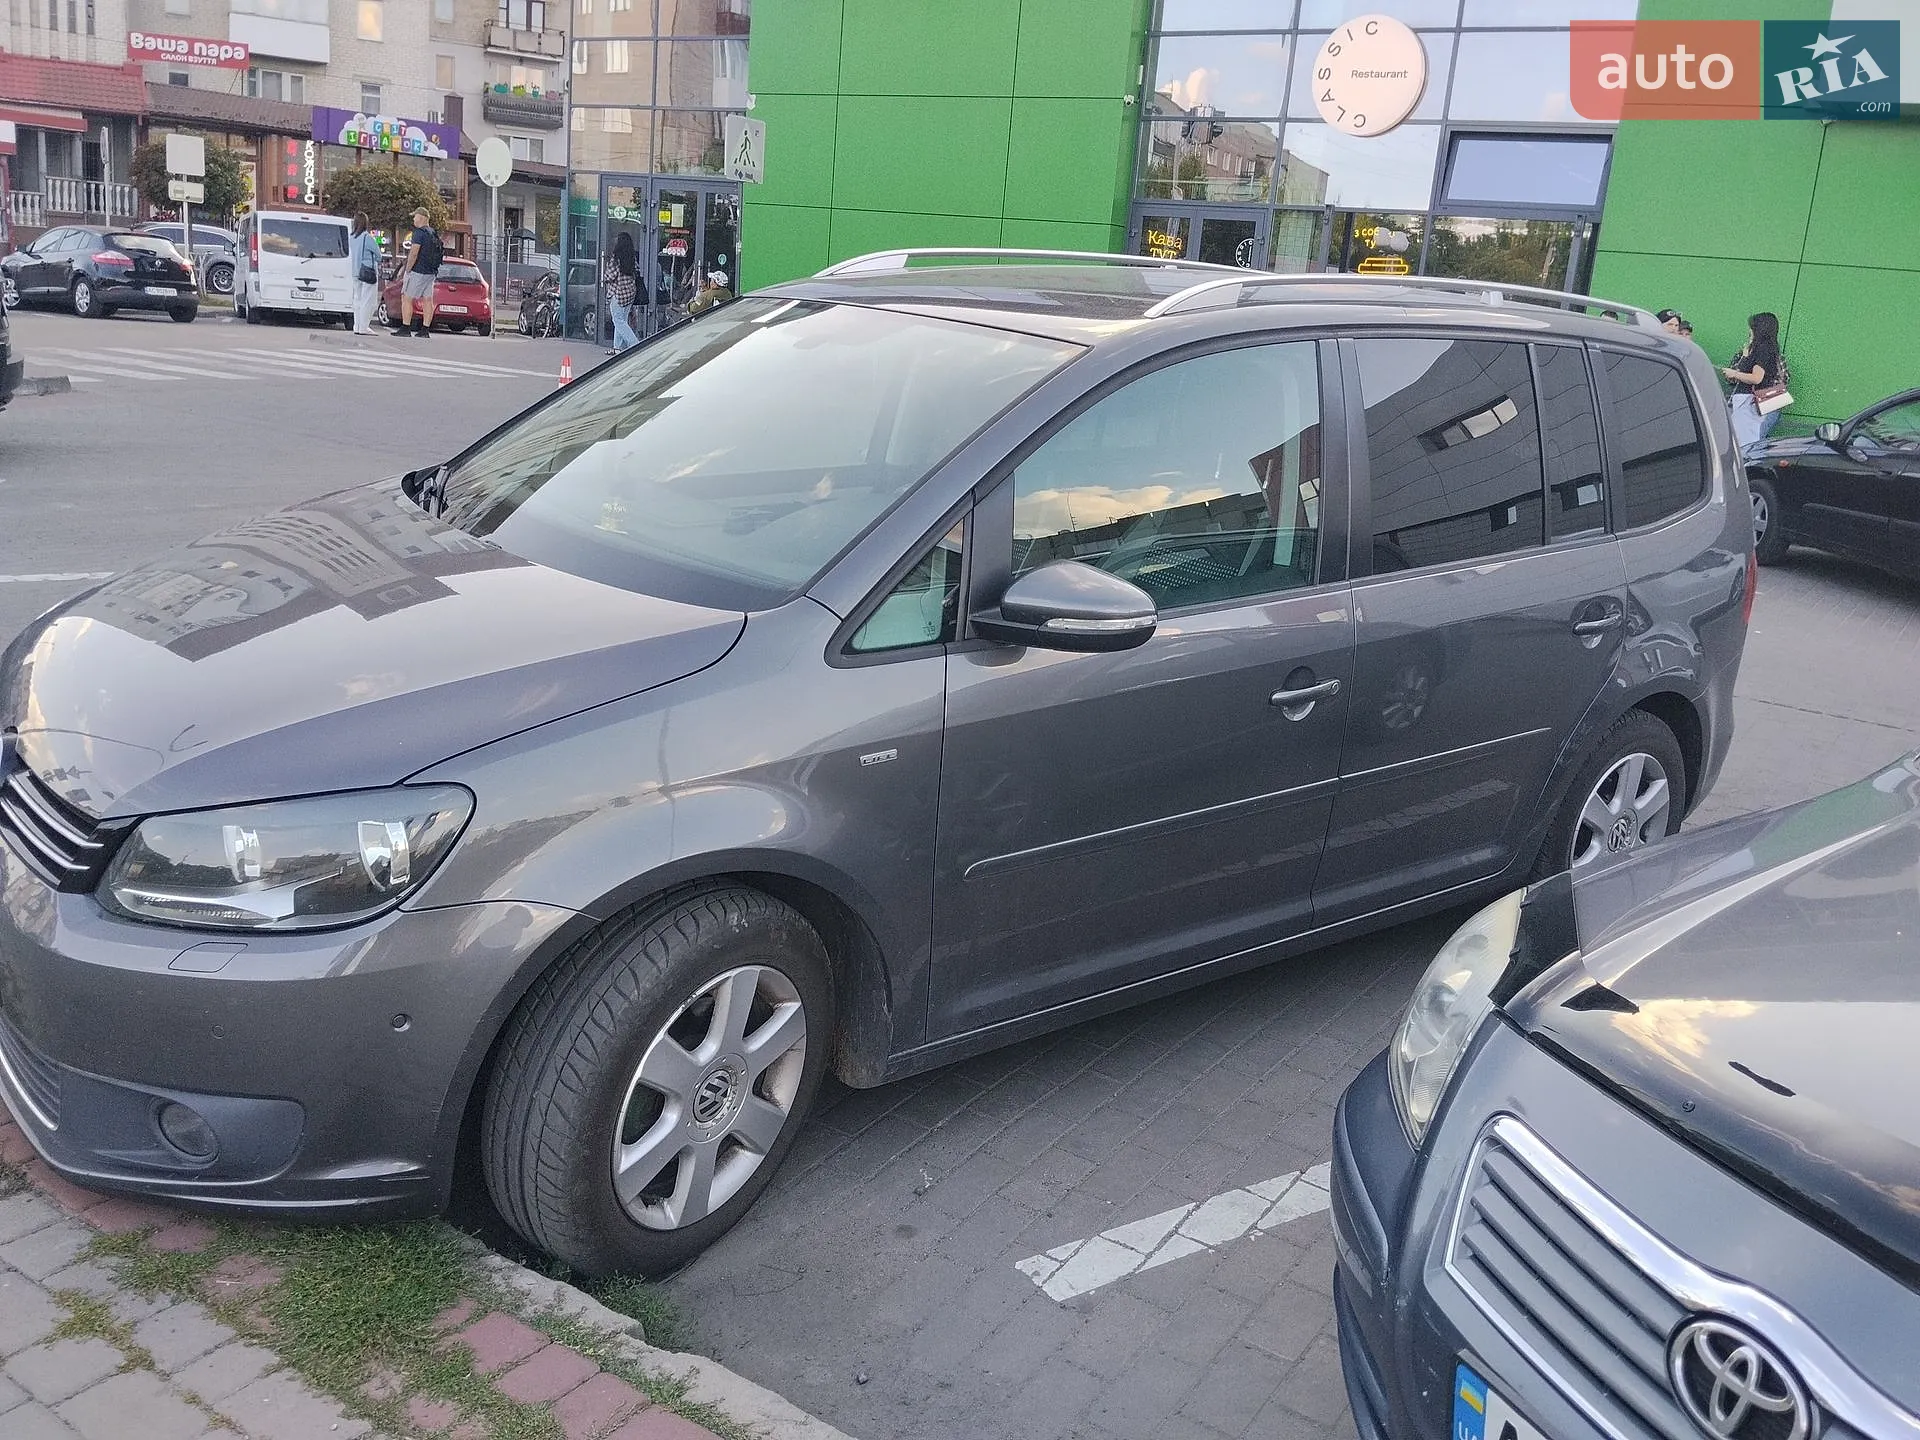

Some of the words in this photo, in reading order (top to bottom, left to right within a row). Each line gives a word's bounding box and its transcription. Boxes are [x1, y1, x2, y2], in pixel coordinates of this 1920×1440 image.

[130, 32, 189, 54] Ваша
[193, 41, 245, 61] пара
[160, 53, 188, 62] САЛОН
[188, 56, 217, 65] ВЗУТТЯ
[1318, 21, 1378, 128] CLASSIC
[1350, 69, 1409, 79] Restaurant
[303, 139, 315, 204] КОЖНОГО
[1148, 229, 1182, 250] Кава
